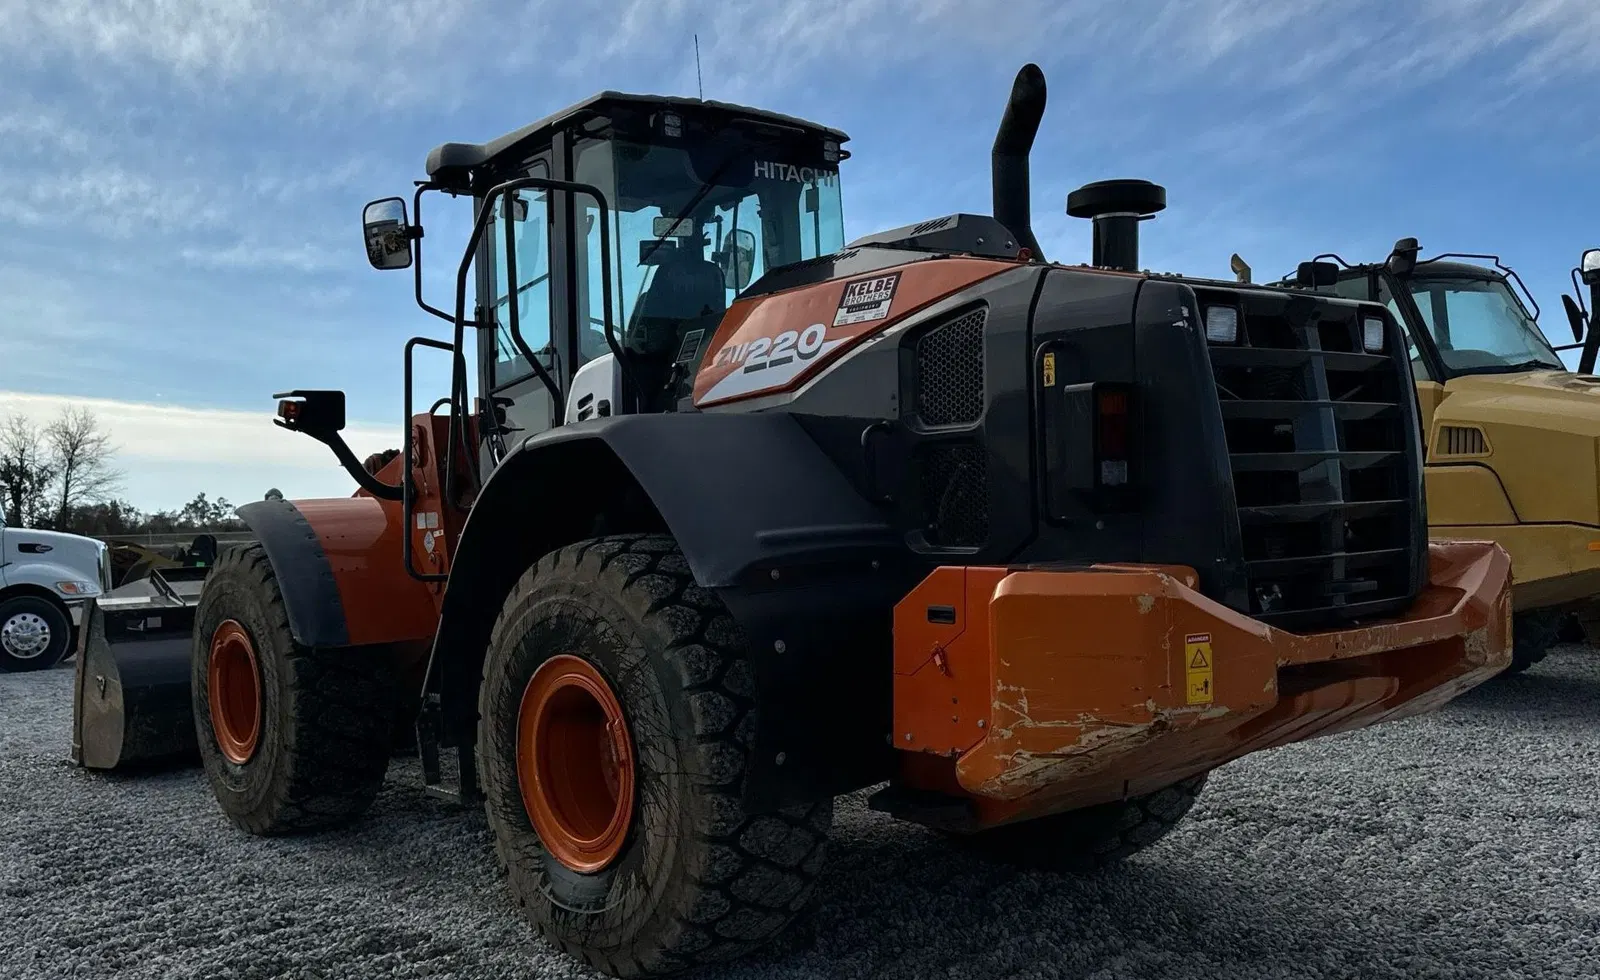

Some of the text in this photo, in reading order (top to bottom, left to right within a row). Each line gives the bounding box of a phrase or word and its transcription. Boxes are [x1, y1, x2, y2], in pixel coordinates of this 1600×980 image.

[754, 160, 834, 188] HITACHI
[845, 290, 890, 306] BROTHERS
[847, 277, 895, 298] KELBE
